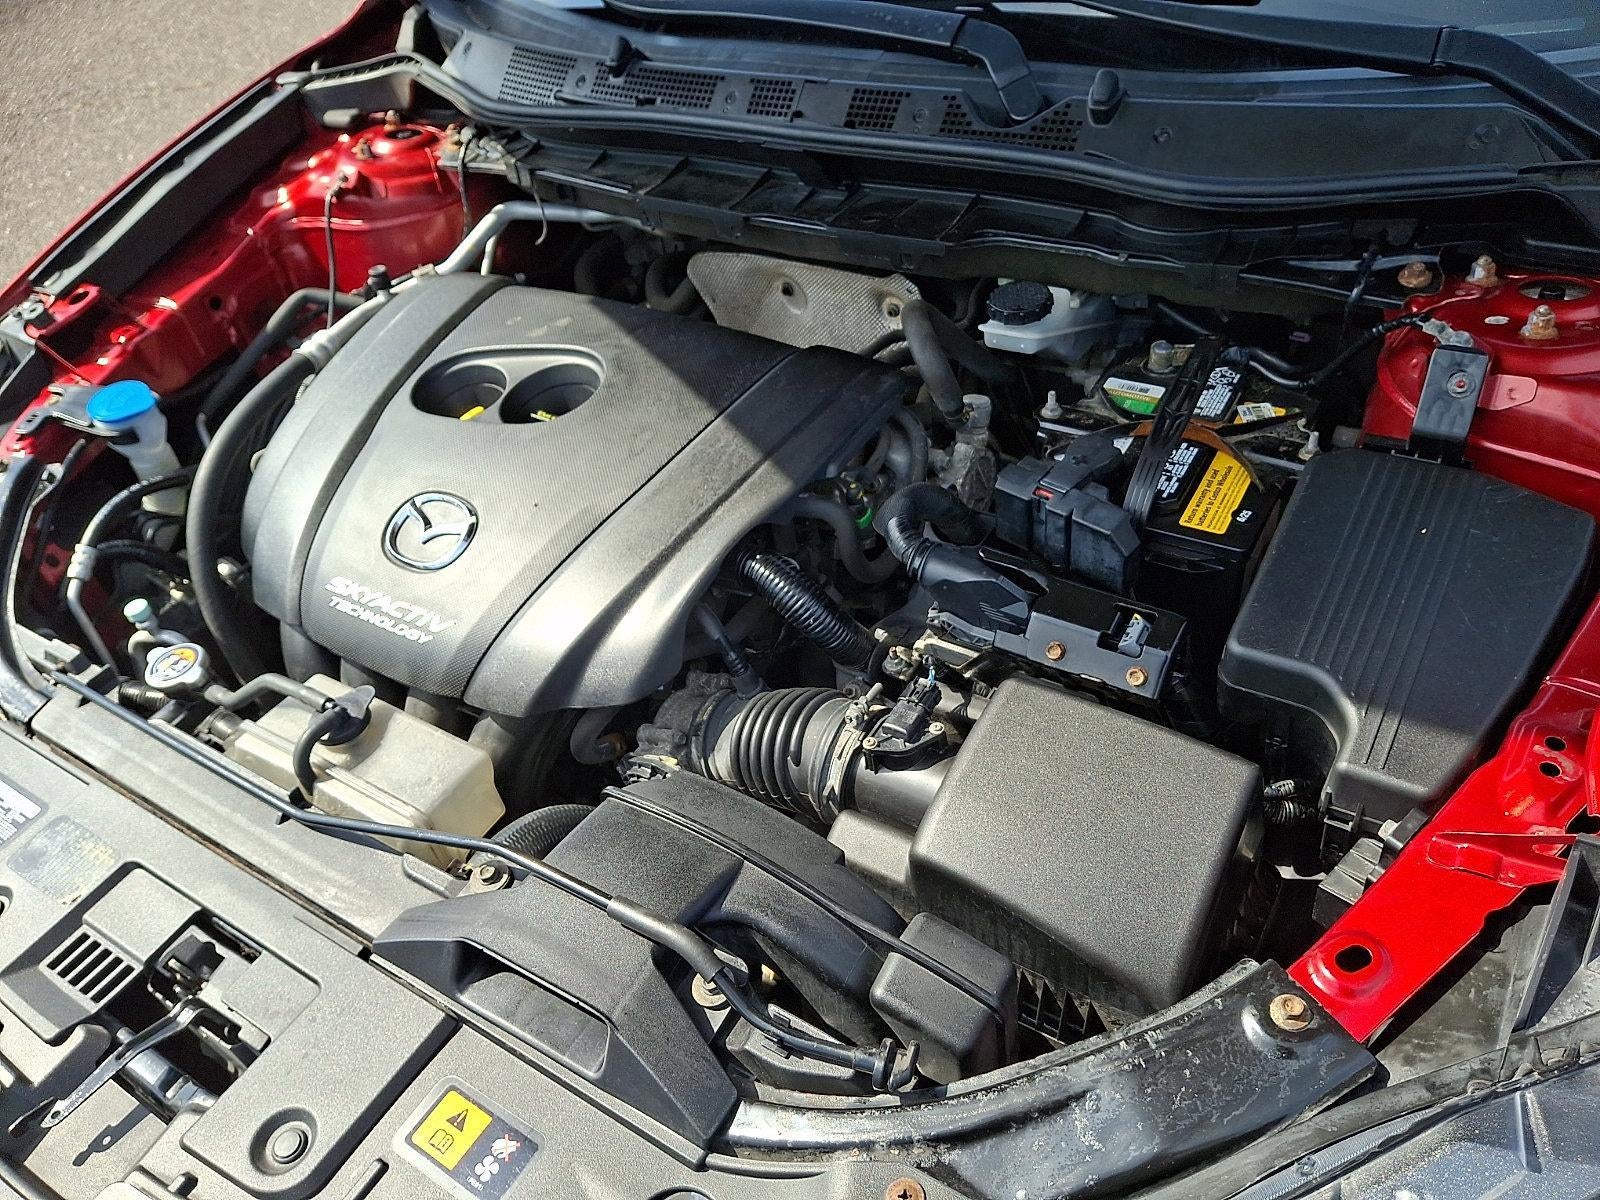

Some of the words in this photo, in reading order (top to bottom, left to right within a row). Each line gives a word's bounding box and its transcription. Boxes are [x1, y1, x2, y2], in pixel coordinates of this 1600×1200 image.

[1183, 507, 1198, 524] Return
[1194, 487, 1210, 508] warranty
[1195, 506, 1212, 526] batteries
[1208, 487, 1222, 501] Costco
[1217, 465, 1234, 487] Wholesale
[324, 576, 456, 633] SKYACTIV
[328, 595, 434, 644] TECHNOLOGY
